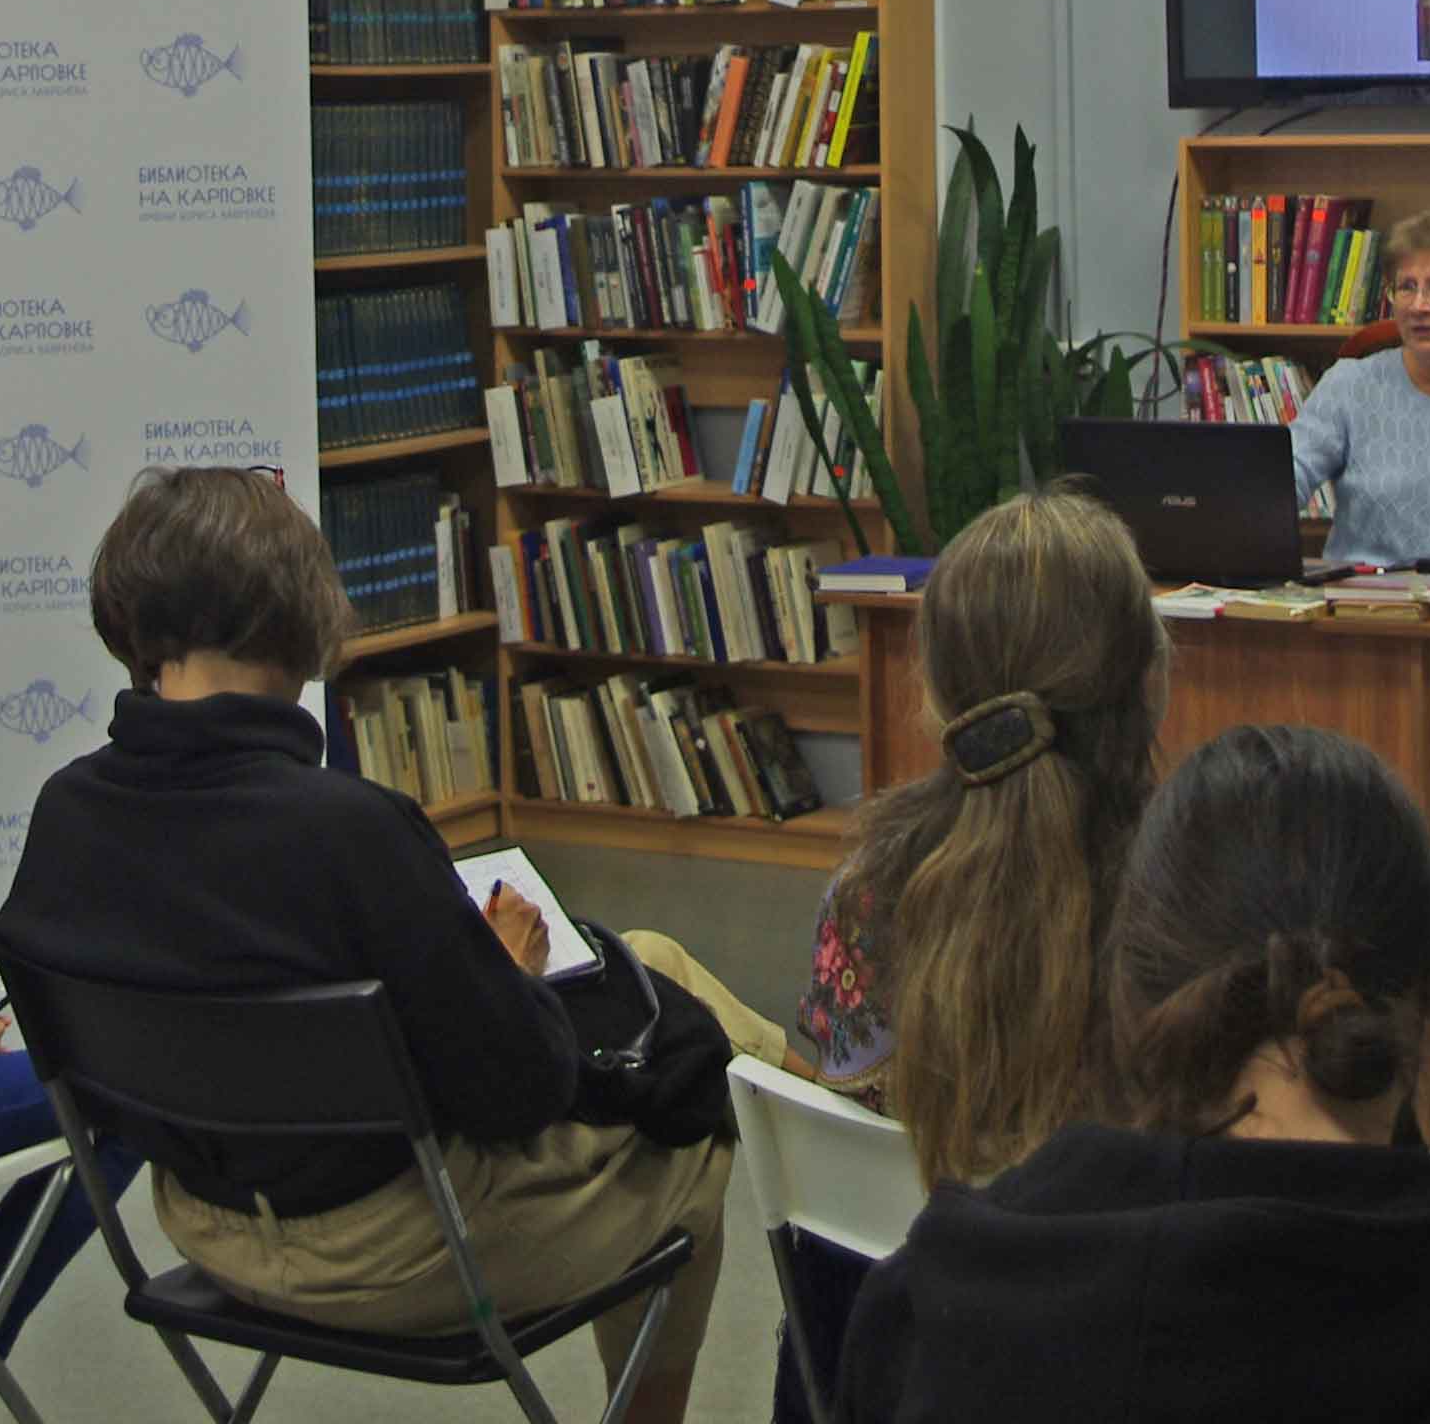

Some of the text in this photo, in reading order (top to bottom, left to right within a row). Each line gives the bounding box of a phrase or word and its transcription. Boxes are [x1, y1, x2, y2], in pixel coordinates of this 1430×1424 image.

[139, 165, 248, 183] БИБЛИОТЕКА
[139, 187, 276, 206] НА КАРПОВКЕ
[144, 420, 255, 439] БИБЛИОТЕКА
[144, 441, 284, 461] НА КАРПОВКЕ
[1, 577, 90, 597] КАРПОВК
